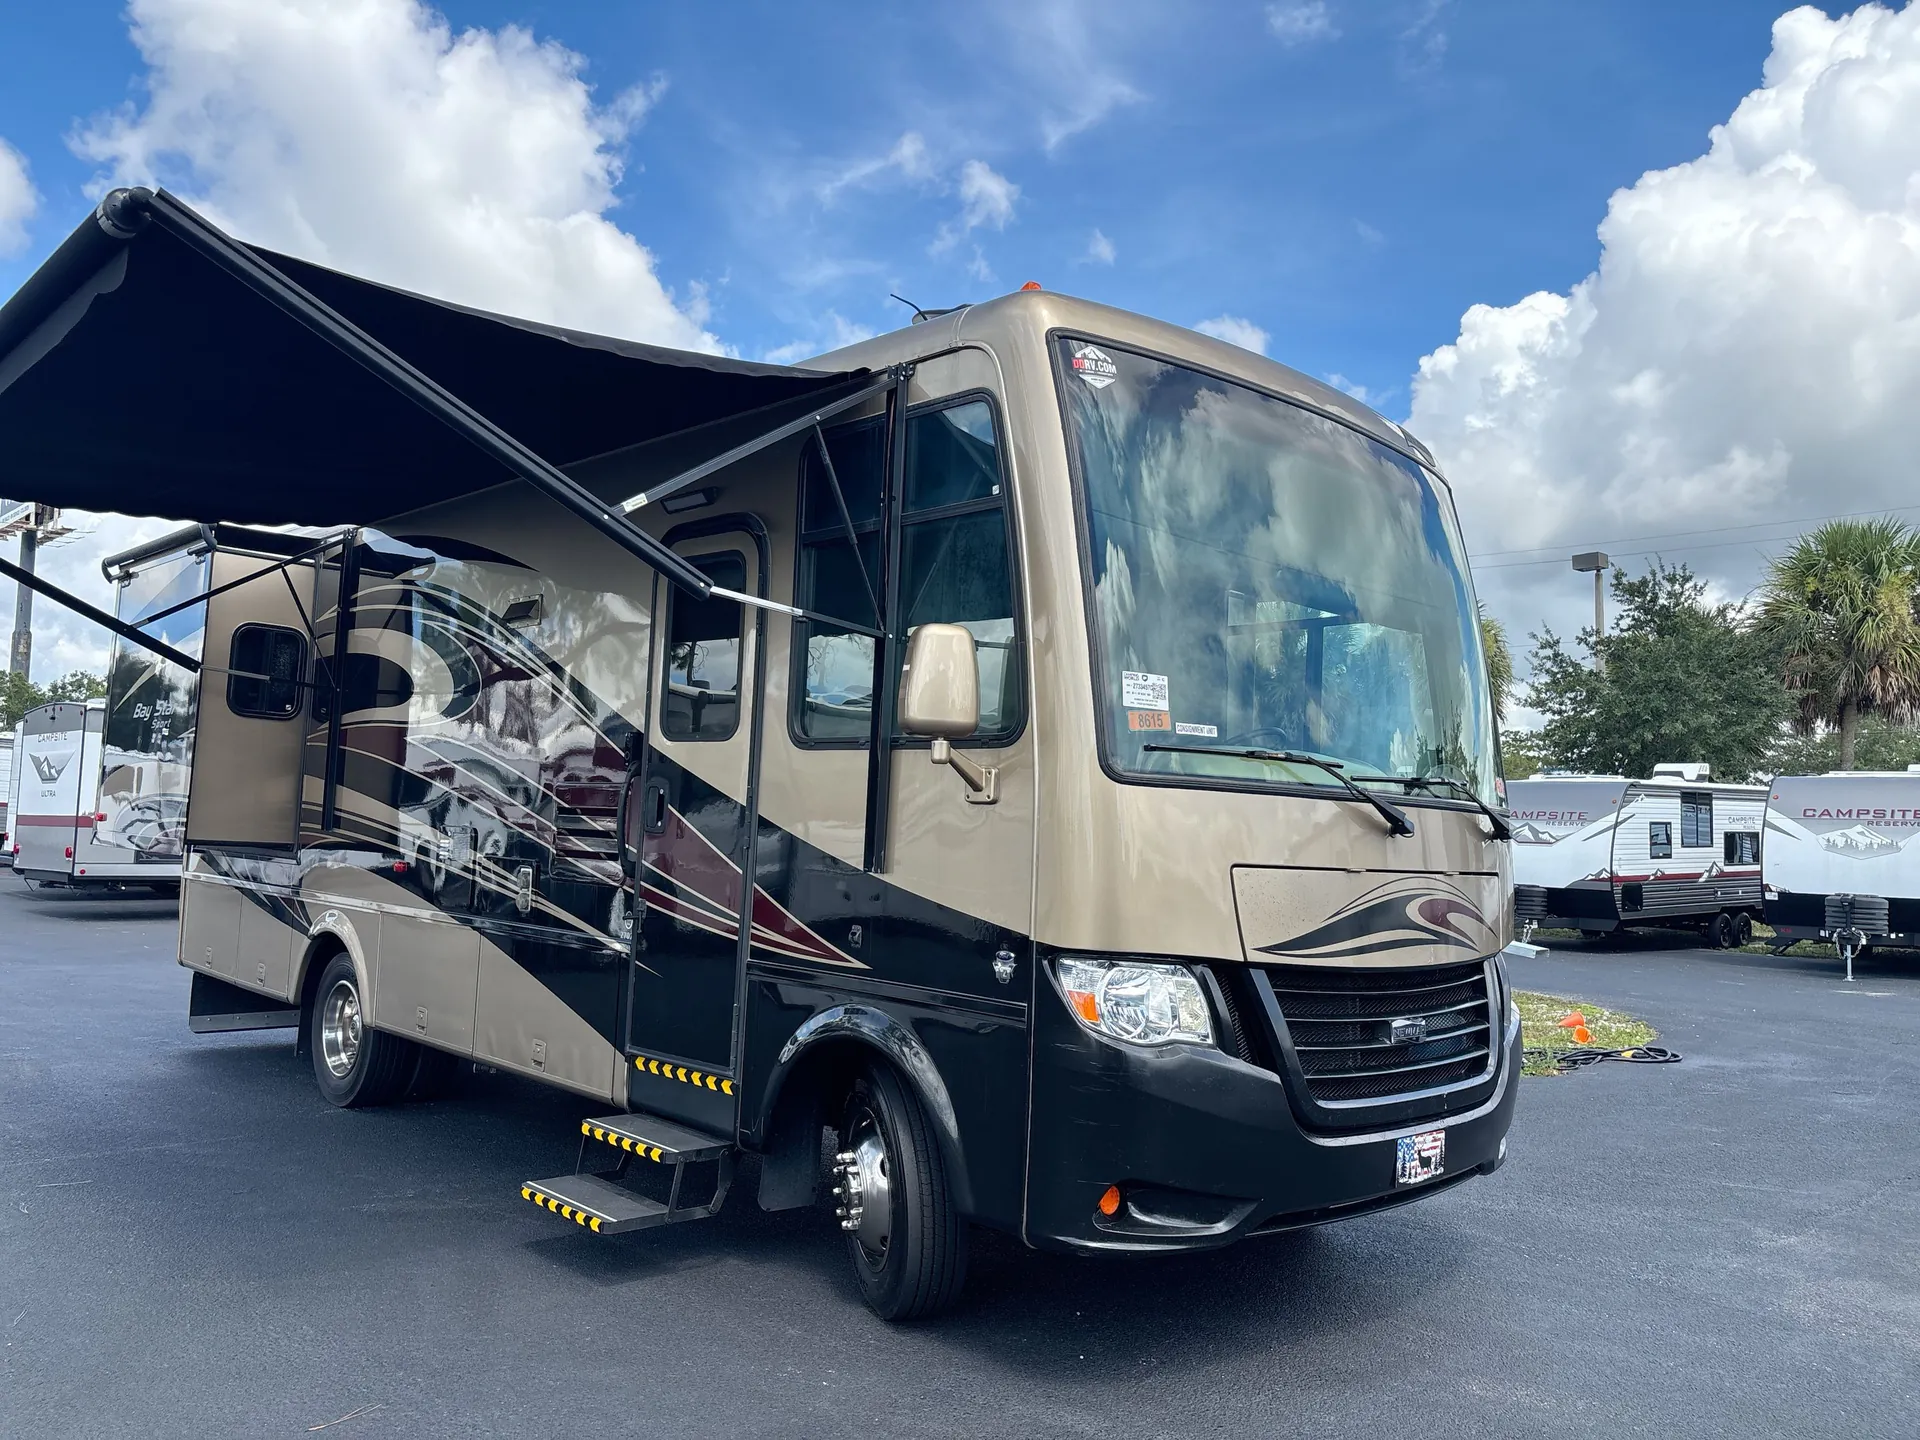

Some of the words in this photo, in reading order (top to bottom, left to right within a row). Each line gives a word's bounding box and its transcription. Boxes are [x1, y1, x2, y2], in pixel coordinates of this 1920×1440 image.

[133, 703, 153, 721] Bay
[151, 718, 171, 730] Sport
[1138, 713, 1163, 728] 8615
[38, 732, 68, 743] CAMPSITE
[41, 790, 56, 798] ULTRA
[1510, 810, 1588, 820] AMPSITE
